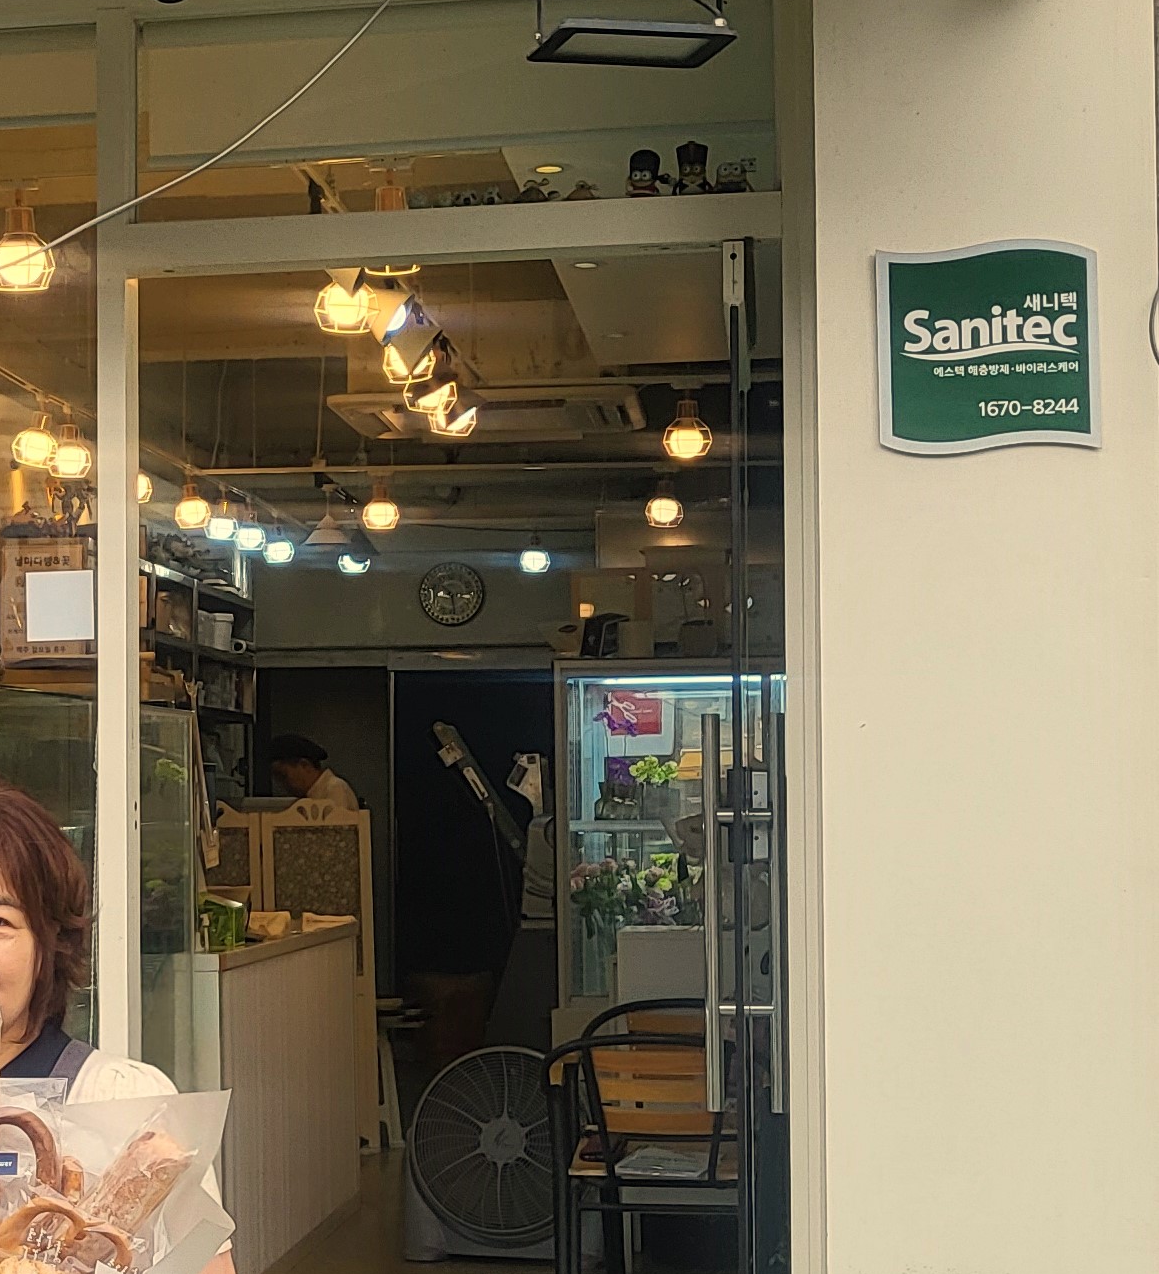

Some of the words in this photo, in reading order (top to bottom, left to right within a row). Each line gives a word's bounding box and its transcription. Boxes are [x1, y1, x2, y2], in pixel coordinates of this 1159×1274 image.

[1023, 291, 1078, 312] 새니텍
[903, 305, 1078, 353] Sanitec
[978, 398, 1080, 417] 1670-8244
